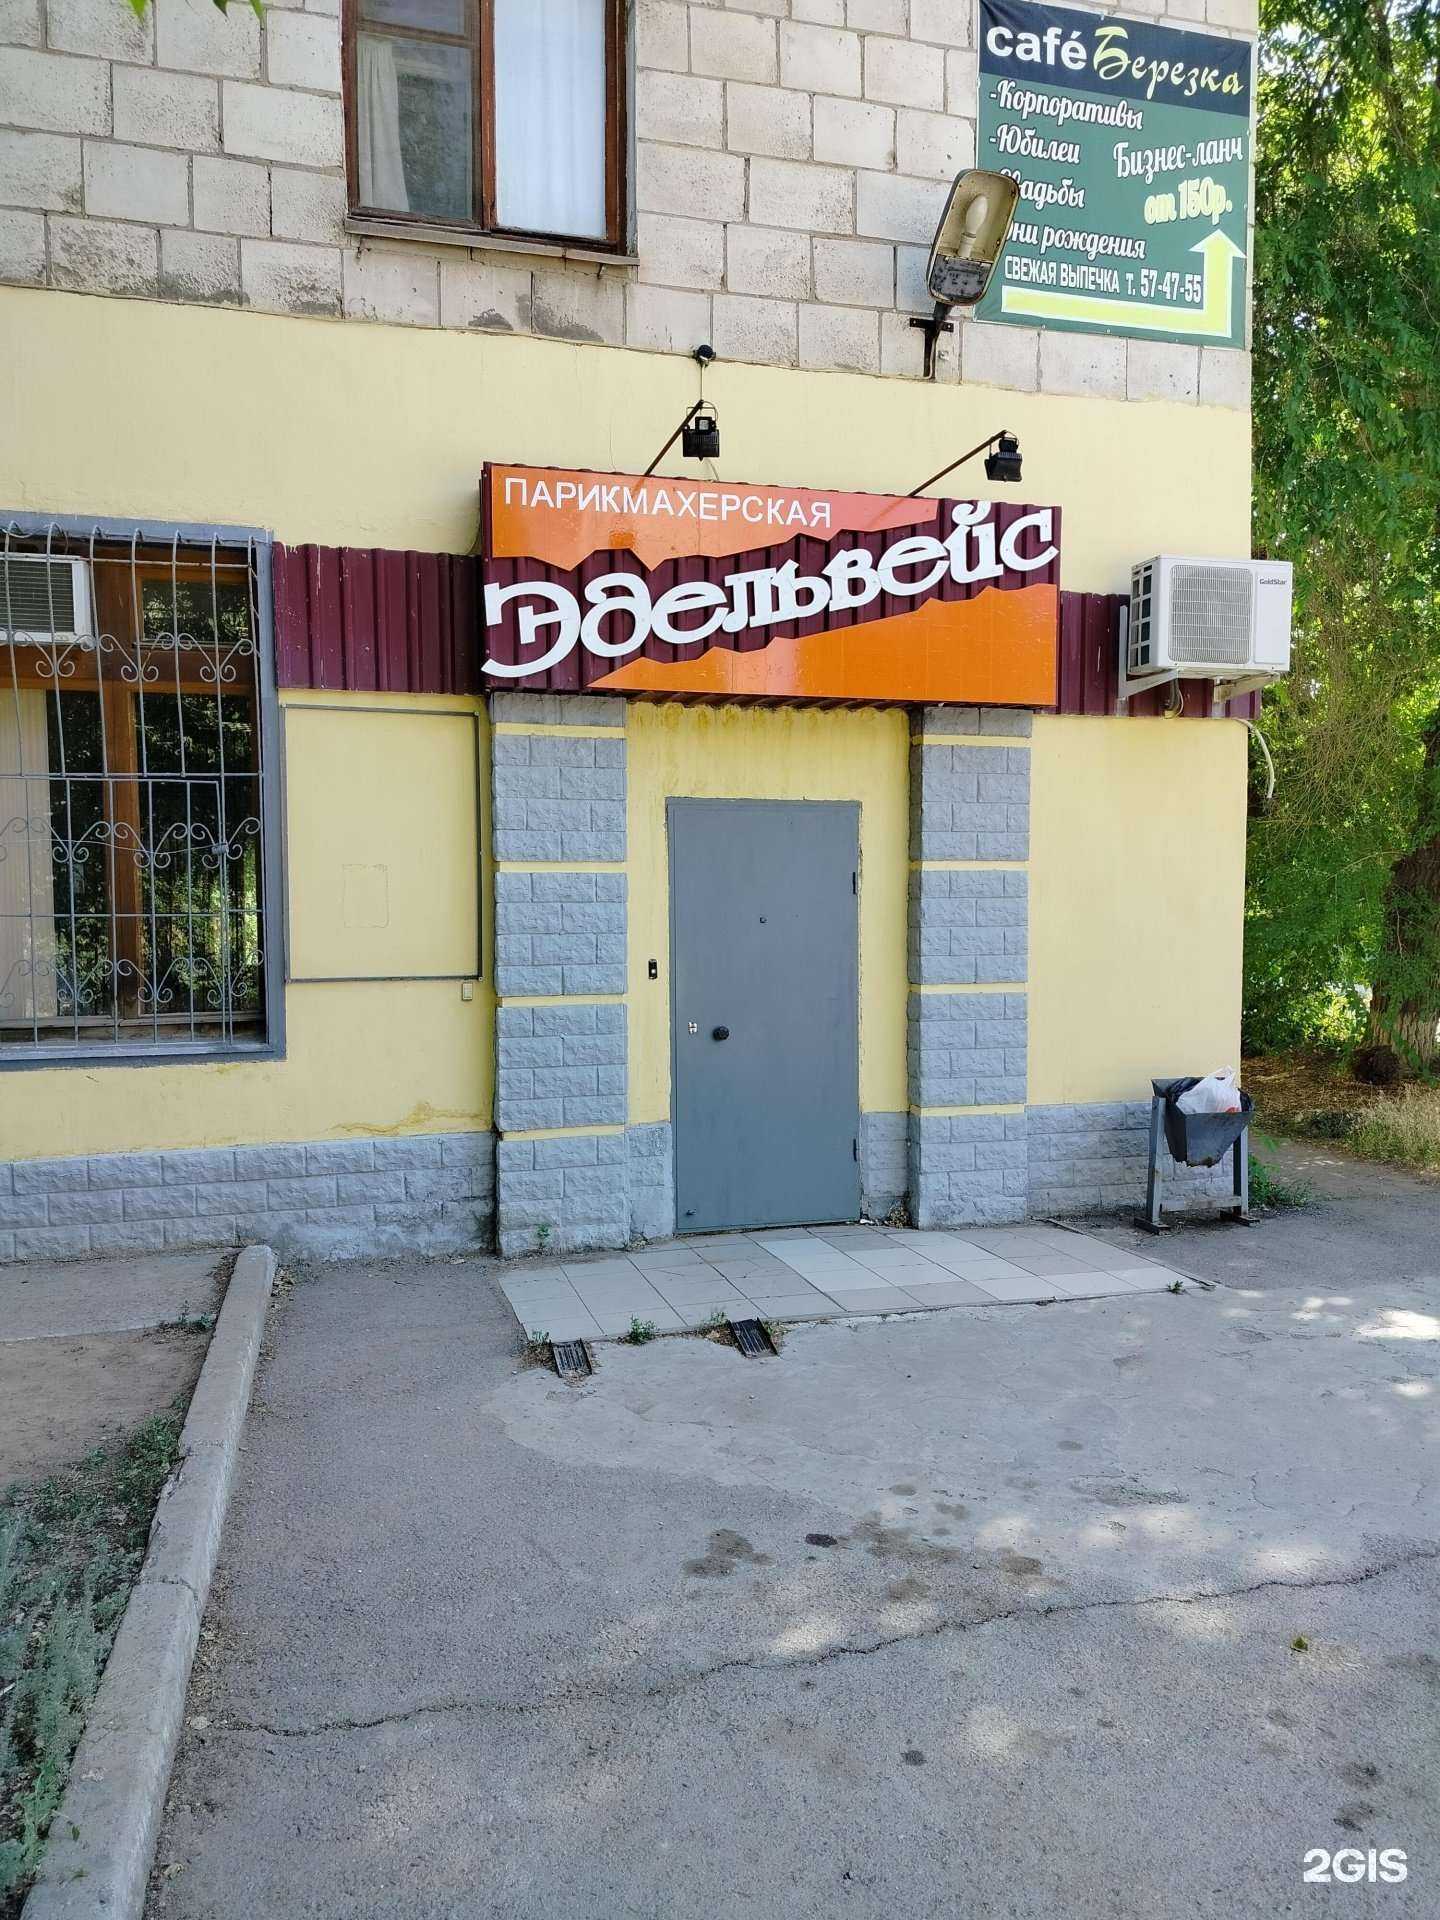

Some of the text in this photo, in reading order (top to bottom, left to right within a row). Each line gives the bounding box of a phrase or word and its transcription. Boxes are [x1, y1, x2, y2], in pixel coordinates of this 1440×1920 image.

[986, 26, 1244, 99] café Березка
[989, 80, 1143, 130] -Корпоративы
[1113, 136, 1243, 181] Бизнес-ланч
[1001, 168, 1085, 210] адьбы
[1144, 176, 1233, 226] от 150р.
[1006, 220, 1147, 261] ни рождения
[1004, 255, 1057, 285] СВЕЖАЯ
[1060, 263, 1120, 295] ВЫПЕЧКА
[1140, 268, 1203, 304] 57-47-55
[505, 477, 832, 529] ПАРИКМАХЕРСКАЯ
[481, 500, 1059, 678] Эдельвейс
